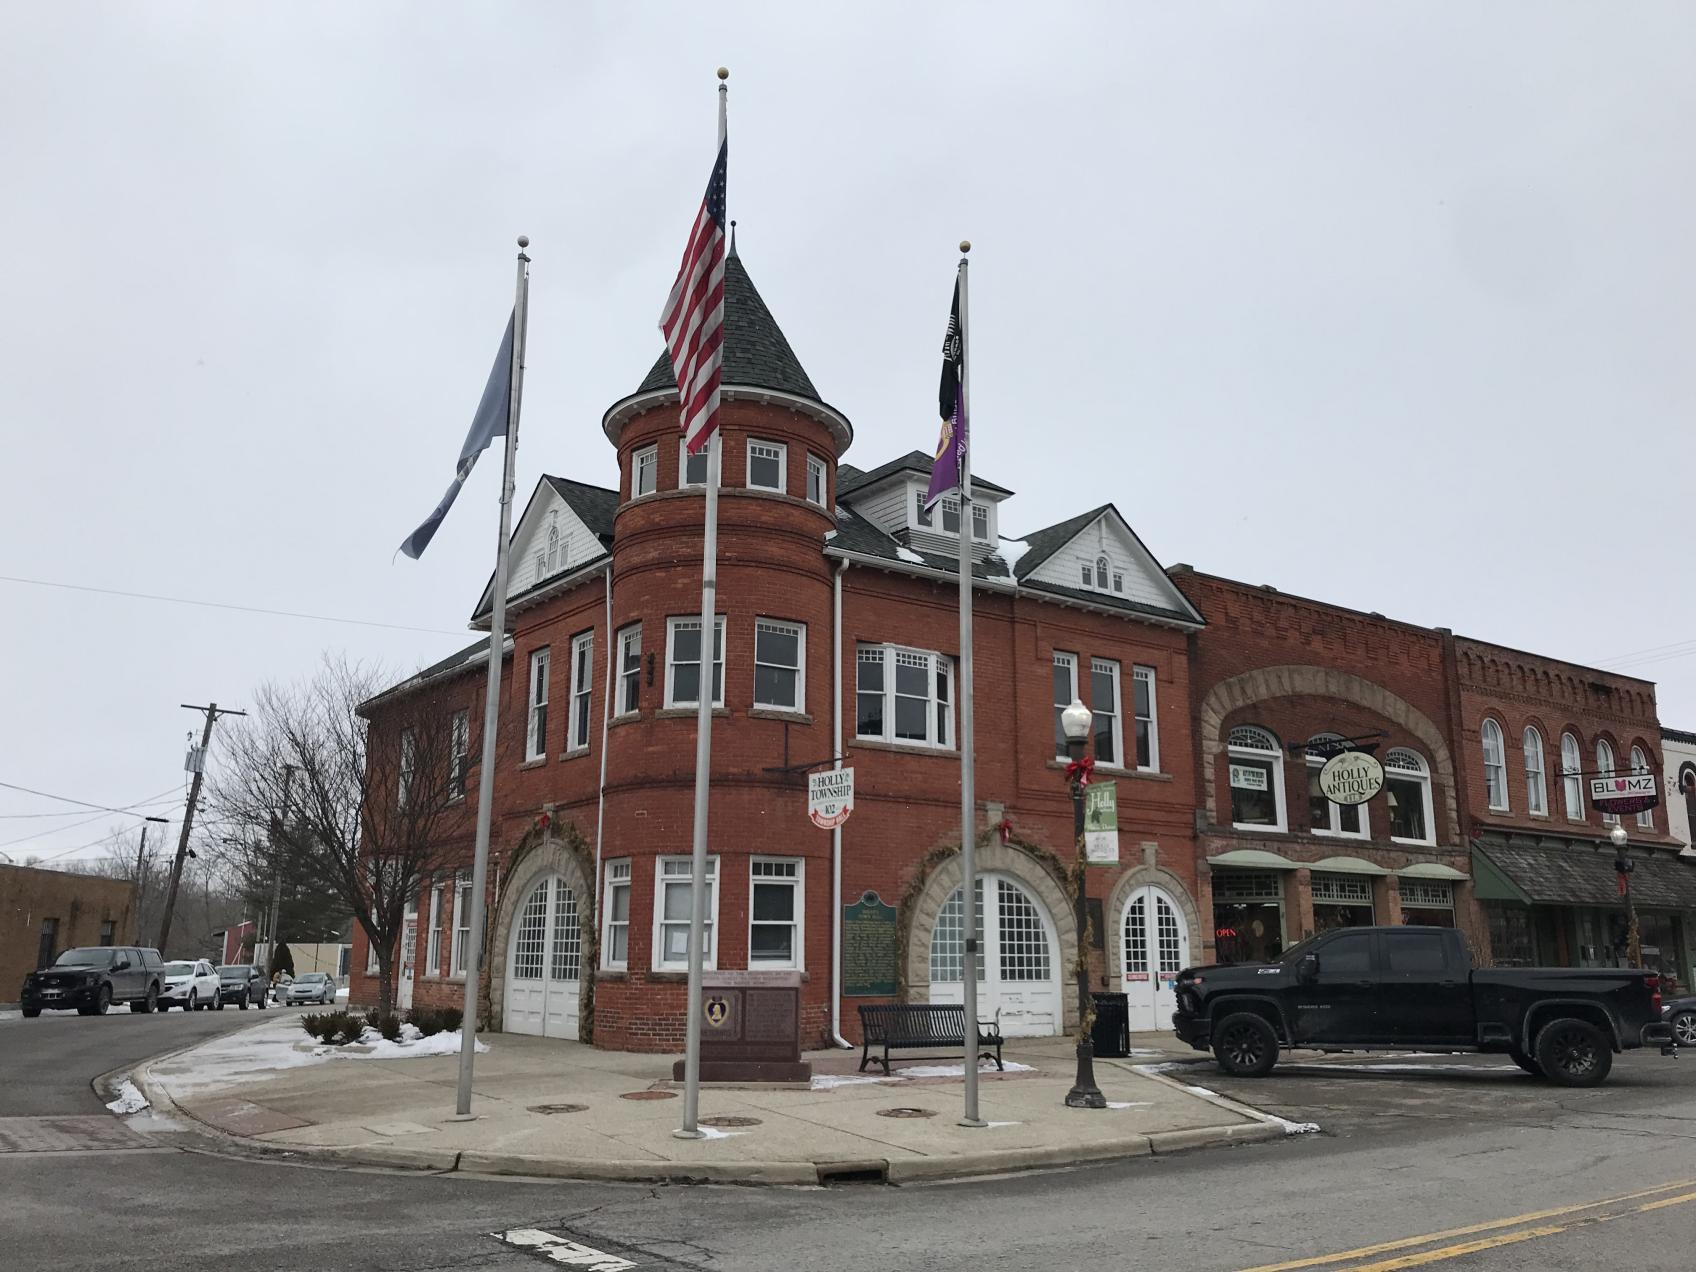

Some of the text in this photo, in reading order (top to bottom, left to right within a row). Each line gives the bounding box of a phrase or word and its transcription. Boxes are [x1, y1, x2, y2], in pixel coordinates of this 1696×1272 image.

[818, 773, 845, 788] HOLLY
[1332, 766, 1370, 782] HOLLY
[811, 785, 852, 801] TOWNSHIP
[1326, 777, 1381, 796] ANTIQUES
[825, 804, 836, 814] 102
[1086, 791, 1115, 815] Holly
[1216, 928, 1237, 938] OPEN
